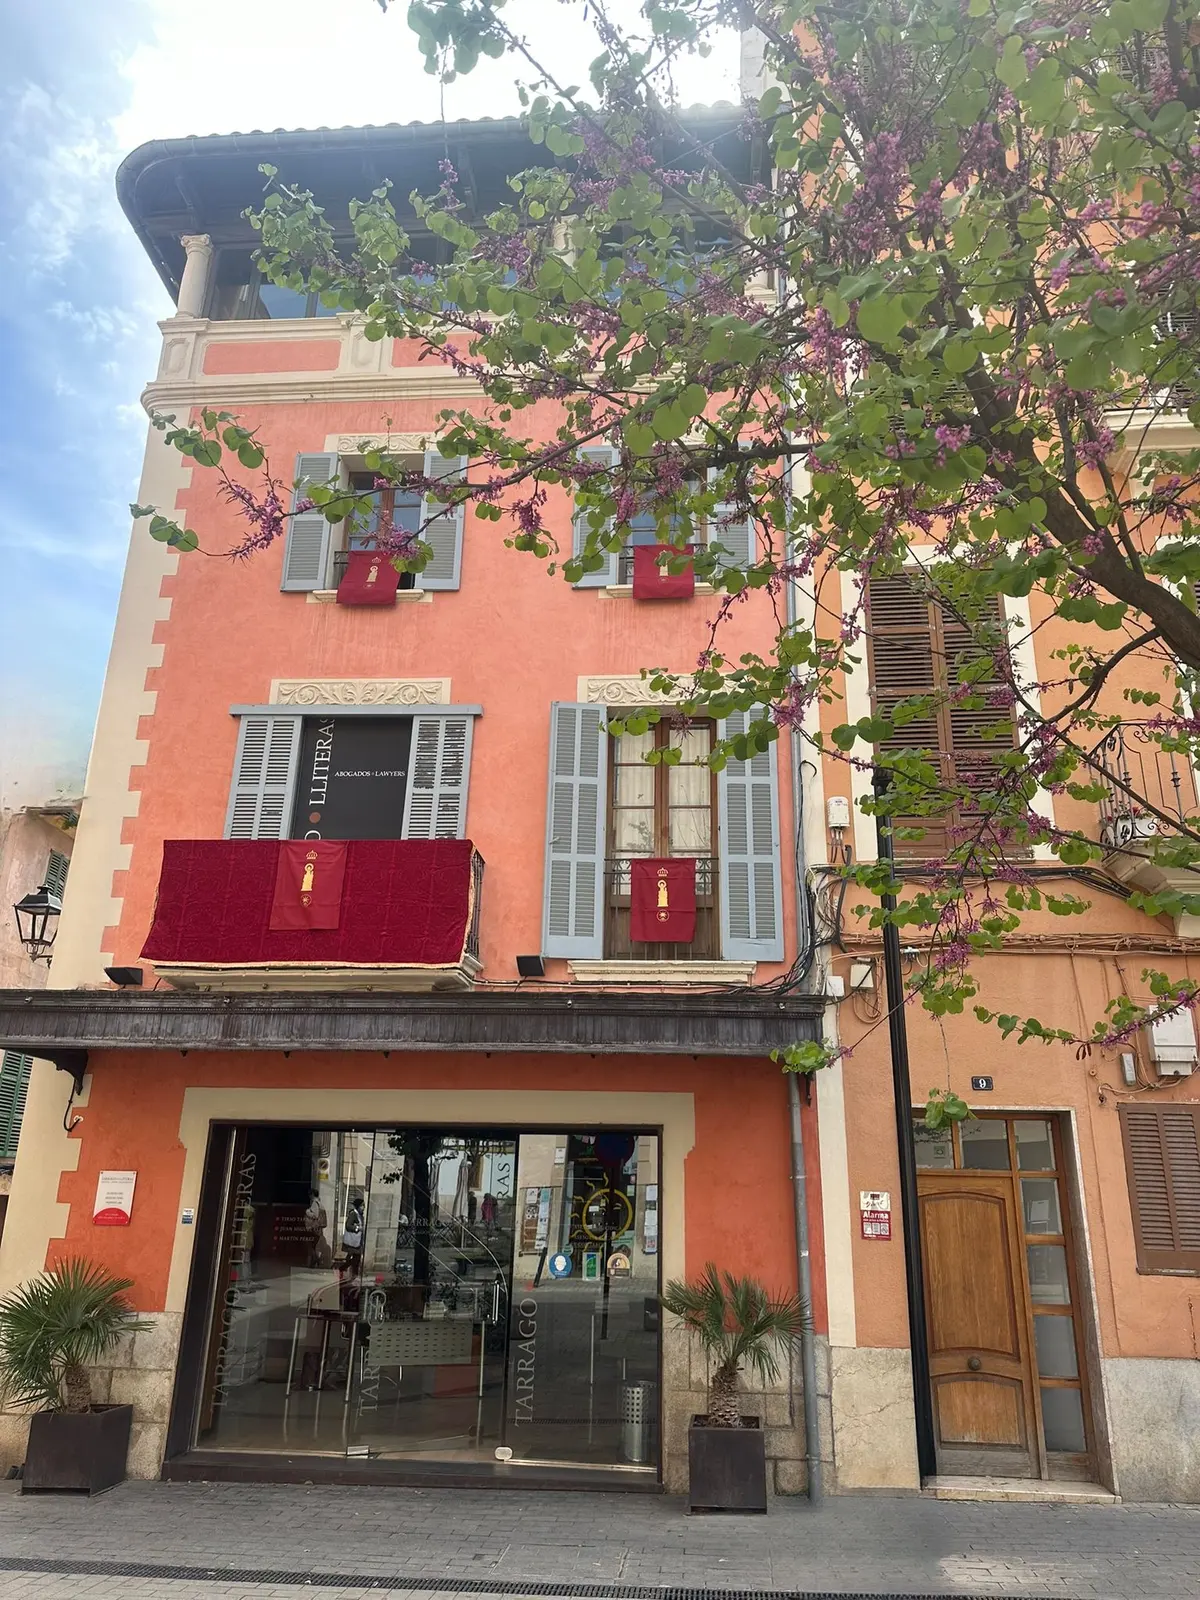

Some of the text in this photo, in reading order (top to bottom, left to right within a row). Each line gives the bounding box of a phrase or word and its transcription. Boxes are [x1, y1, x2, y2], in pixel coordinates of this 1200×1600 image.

[978, 1078, 987, 1089] 9
[229, 1152, 257, 1265] LLITERAS
[514, 1297, 539, 1428] TARRAGO
